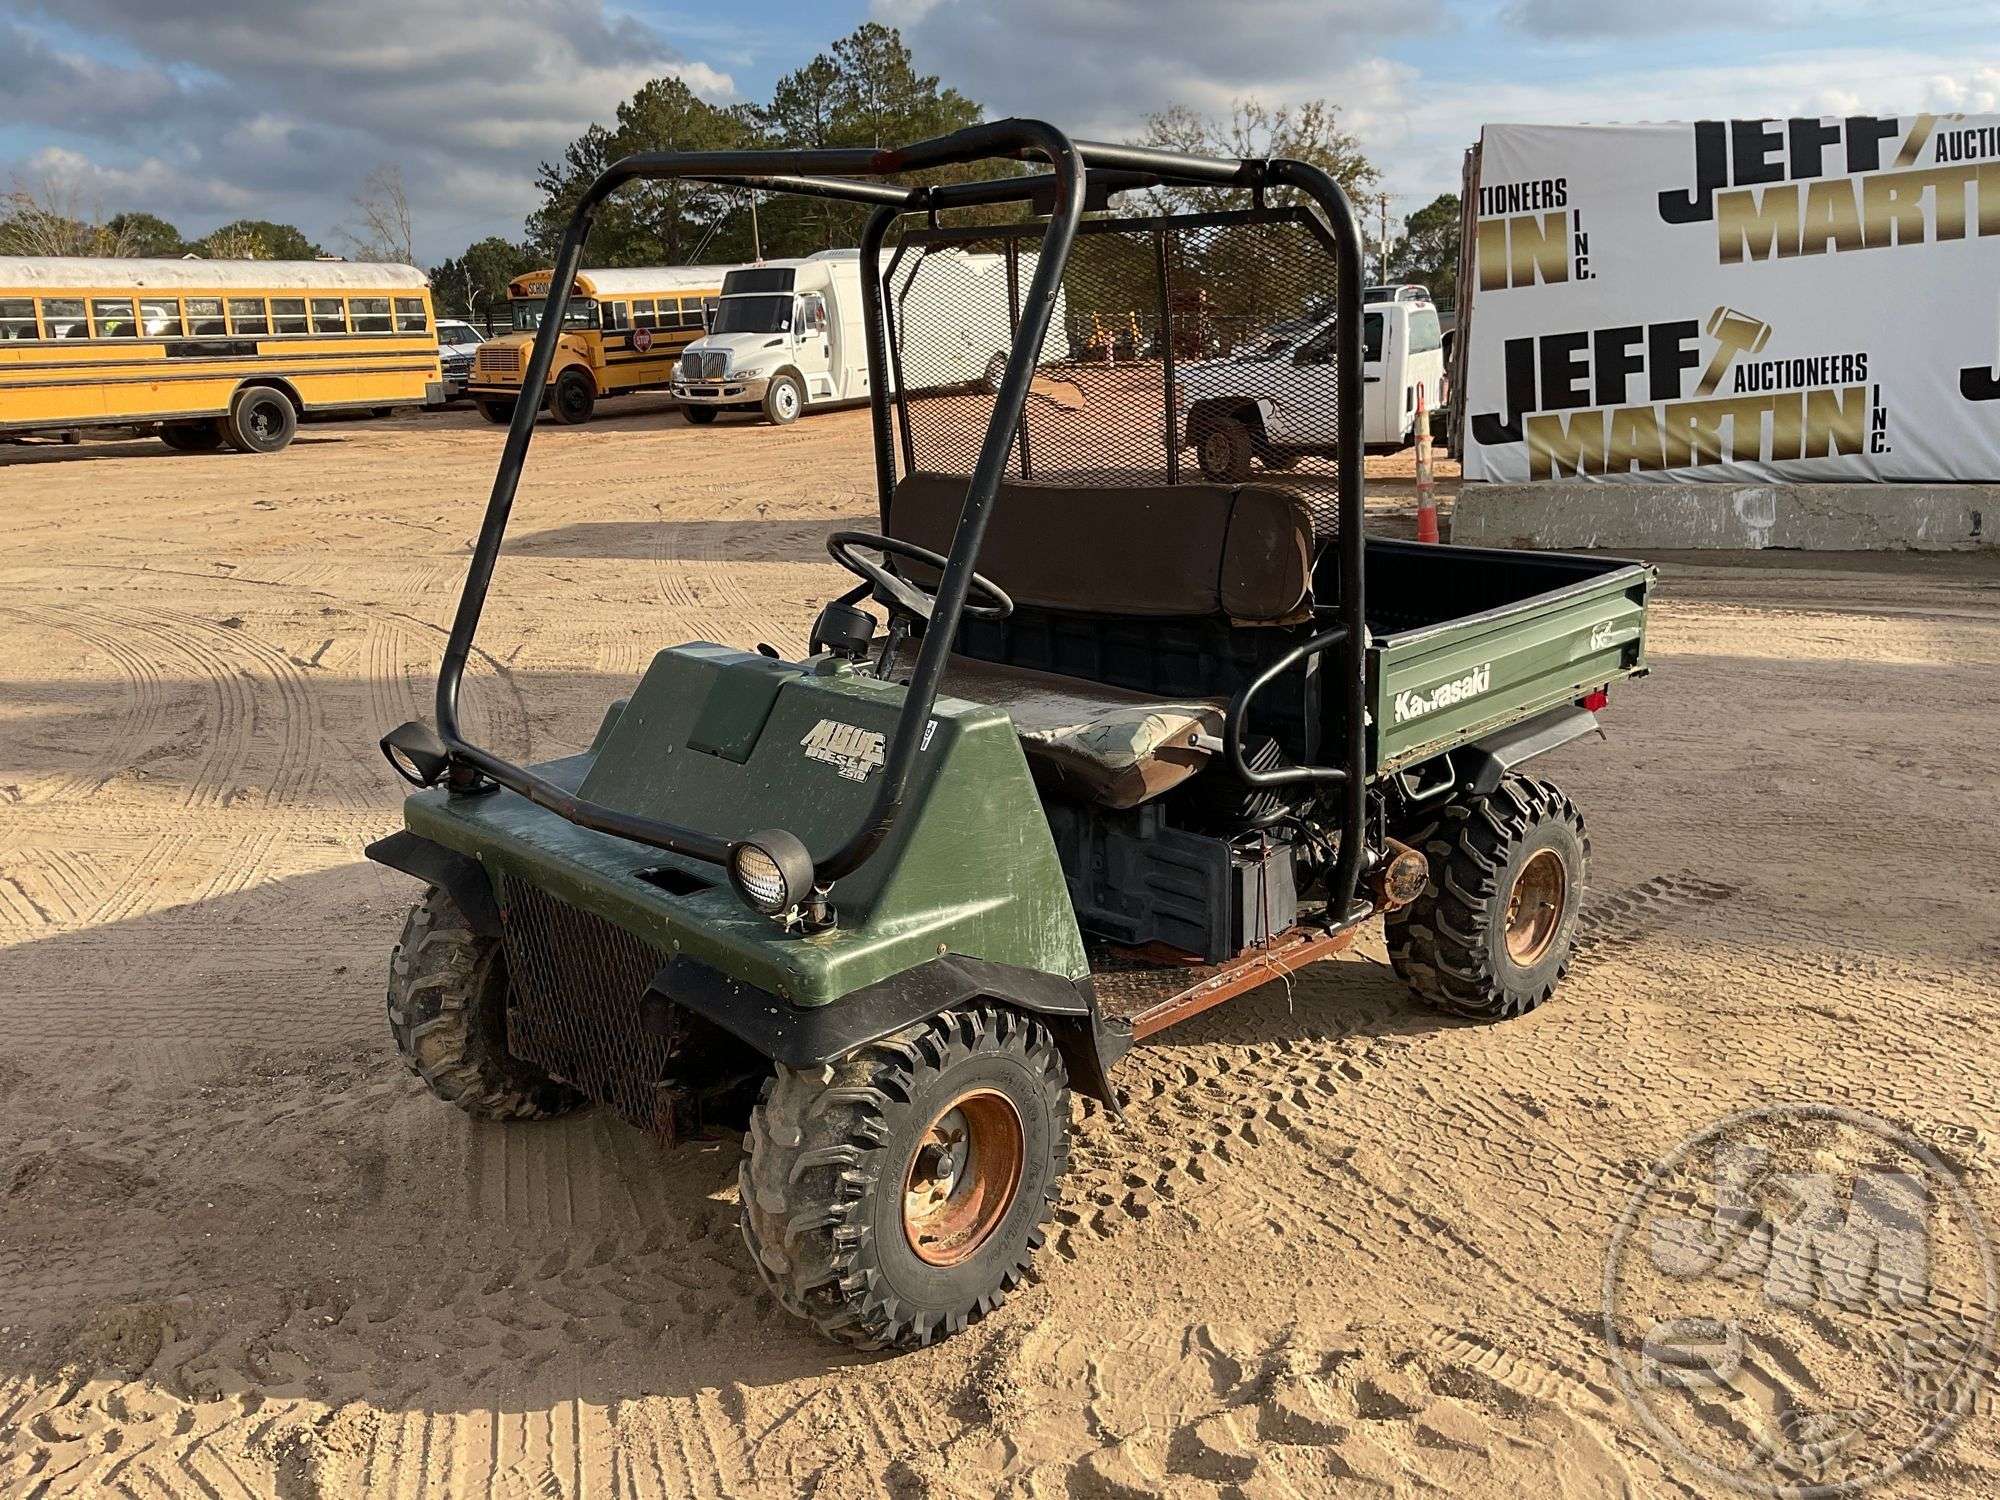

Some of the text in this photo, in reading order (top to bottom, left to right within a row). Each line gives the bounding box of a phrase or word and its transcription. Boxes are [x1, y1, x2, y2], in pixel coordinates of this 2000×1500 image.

[1658, 117, 1898, 224] JEFF
[1936, 127, 2000, 162] AUCTI
[1574, 209, 1596, 280] INC.
[636, 335, 649, 344] STOP
[1472, 320, 1699, 445] JEFF
[1734, 353, 1867, 393] AUCTIONEERS
[1527, 386, 1865, 481] MARTIN
[1871, 384, 1891, 453] INC.
[1394, 662, 1490, 723] Kawasaki
[800, 719, 886, 767] MULE
